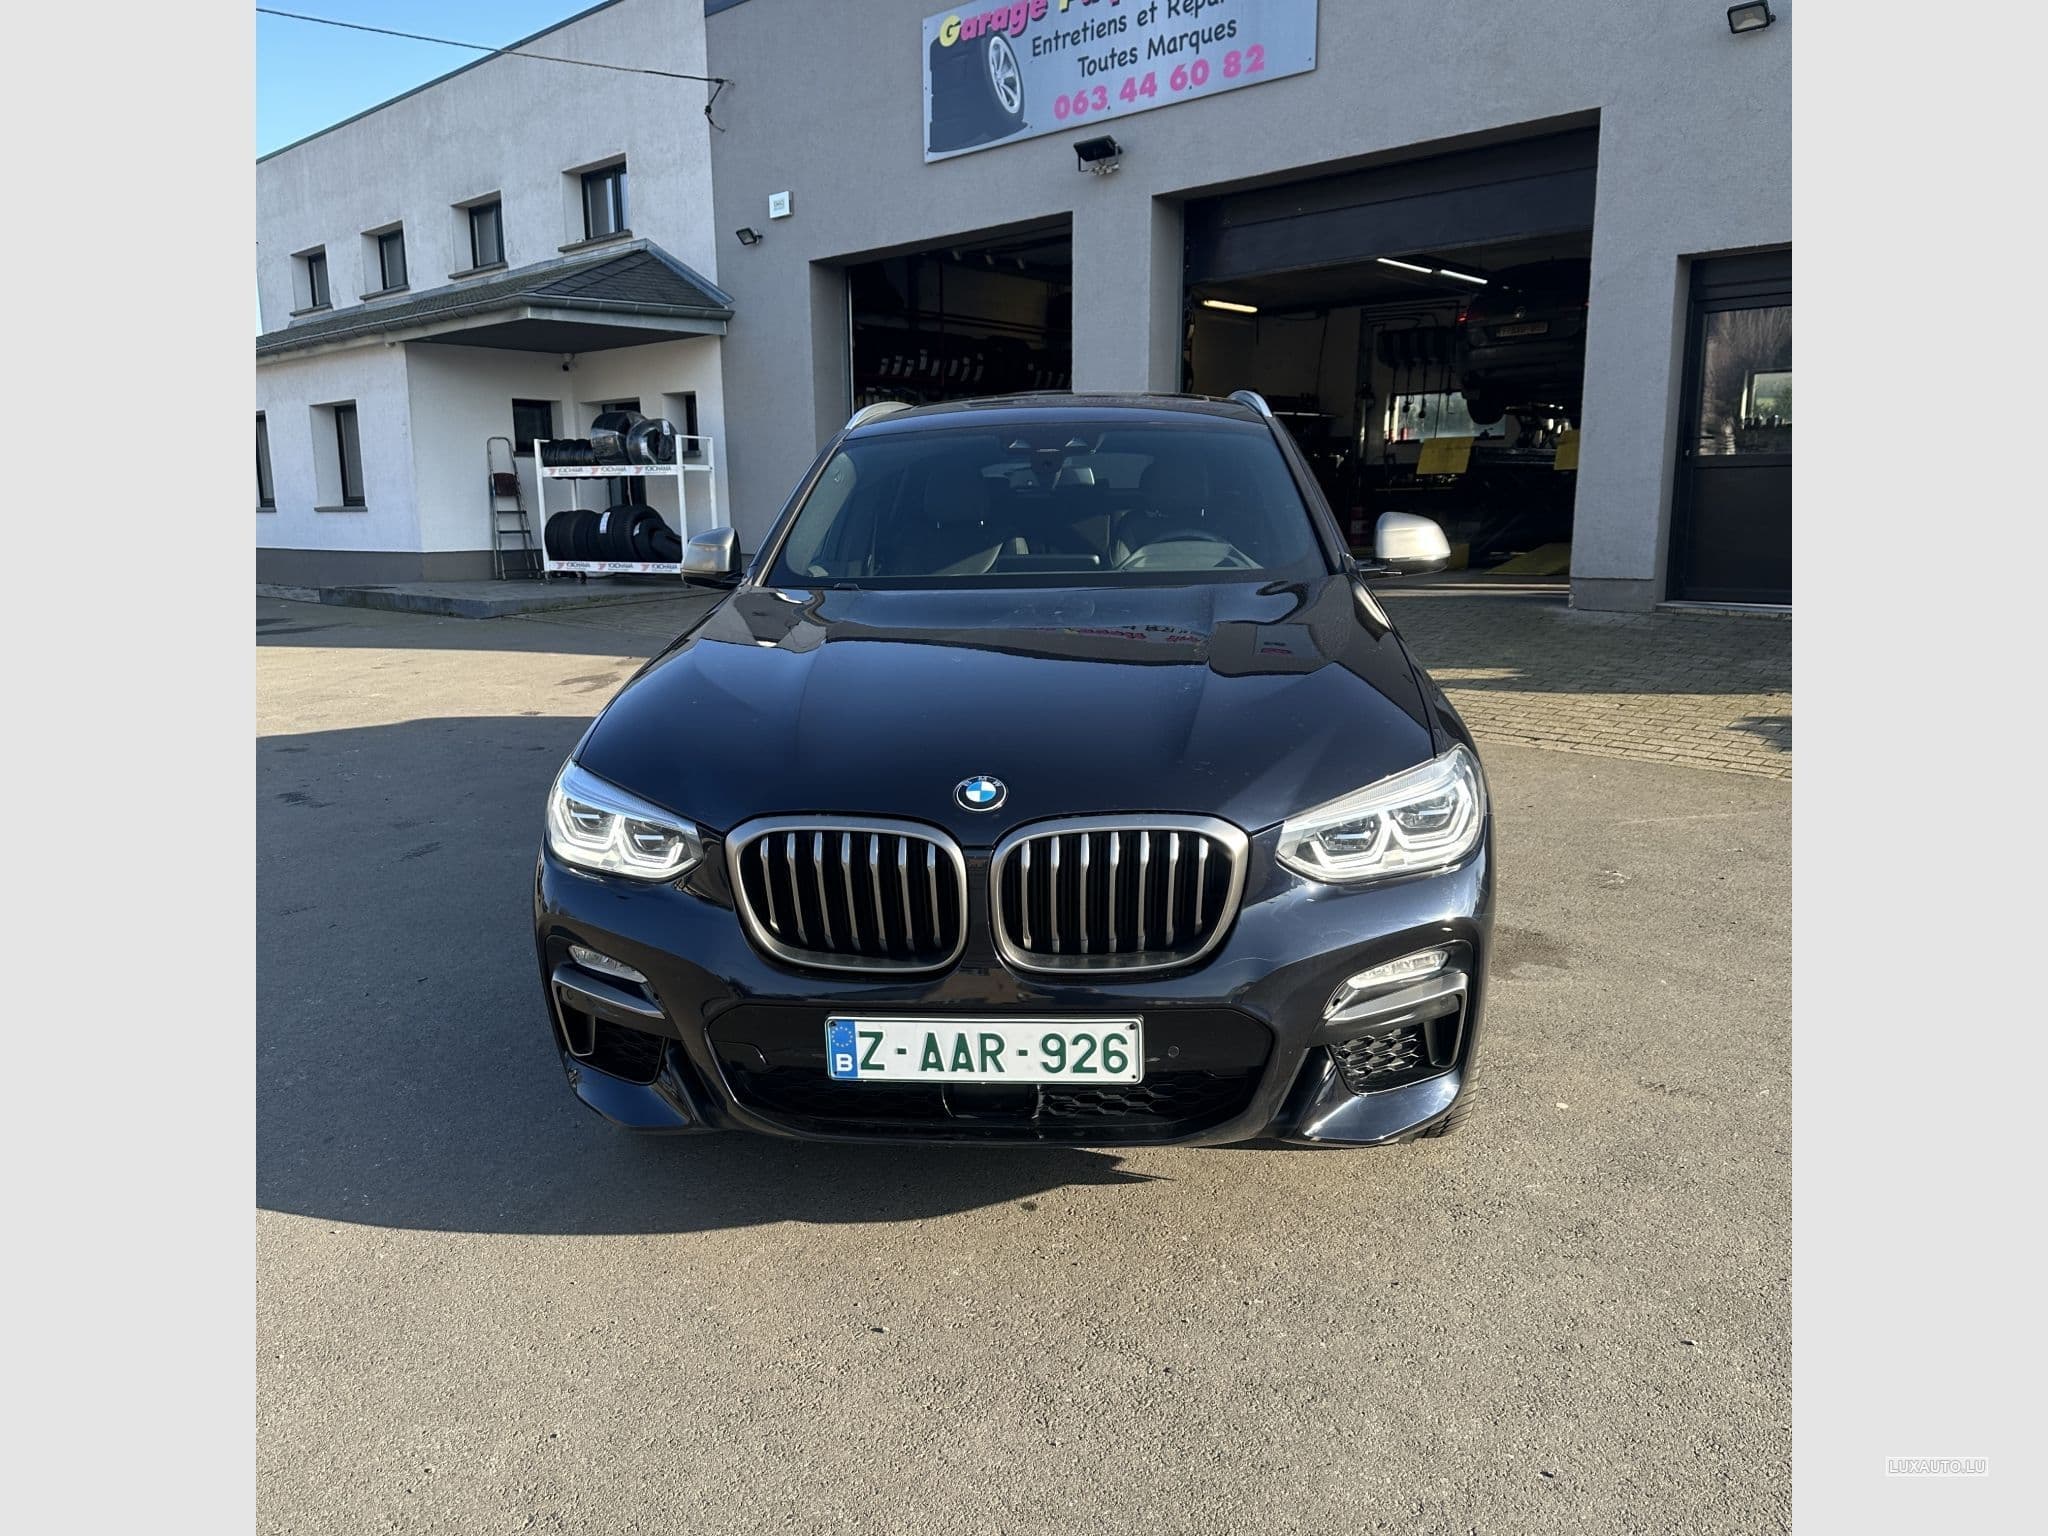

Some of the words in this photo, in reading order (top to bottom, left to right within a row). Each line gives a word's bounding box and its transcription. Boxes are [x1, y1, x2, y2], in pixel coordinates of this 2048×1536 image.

[939, 0, 1049, 47] Garage
[1032, 14, 1127, 57] Entretiens
[1137, 3, 1158, 27] et
[1077, 47, 1138, 78] Toutes
[1147, 19, 1237, 60] Marques
[1054, 85, 1108, 120] 063
[1119, 71, 1158, 103] 44
[1169, 58, 1210, 91] 60
[1223, 44, 1265, 78] 82
[835, 1052, 854, 1072] B
